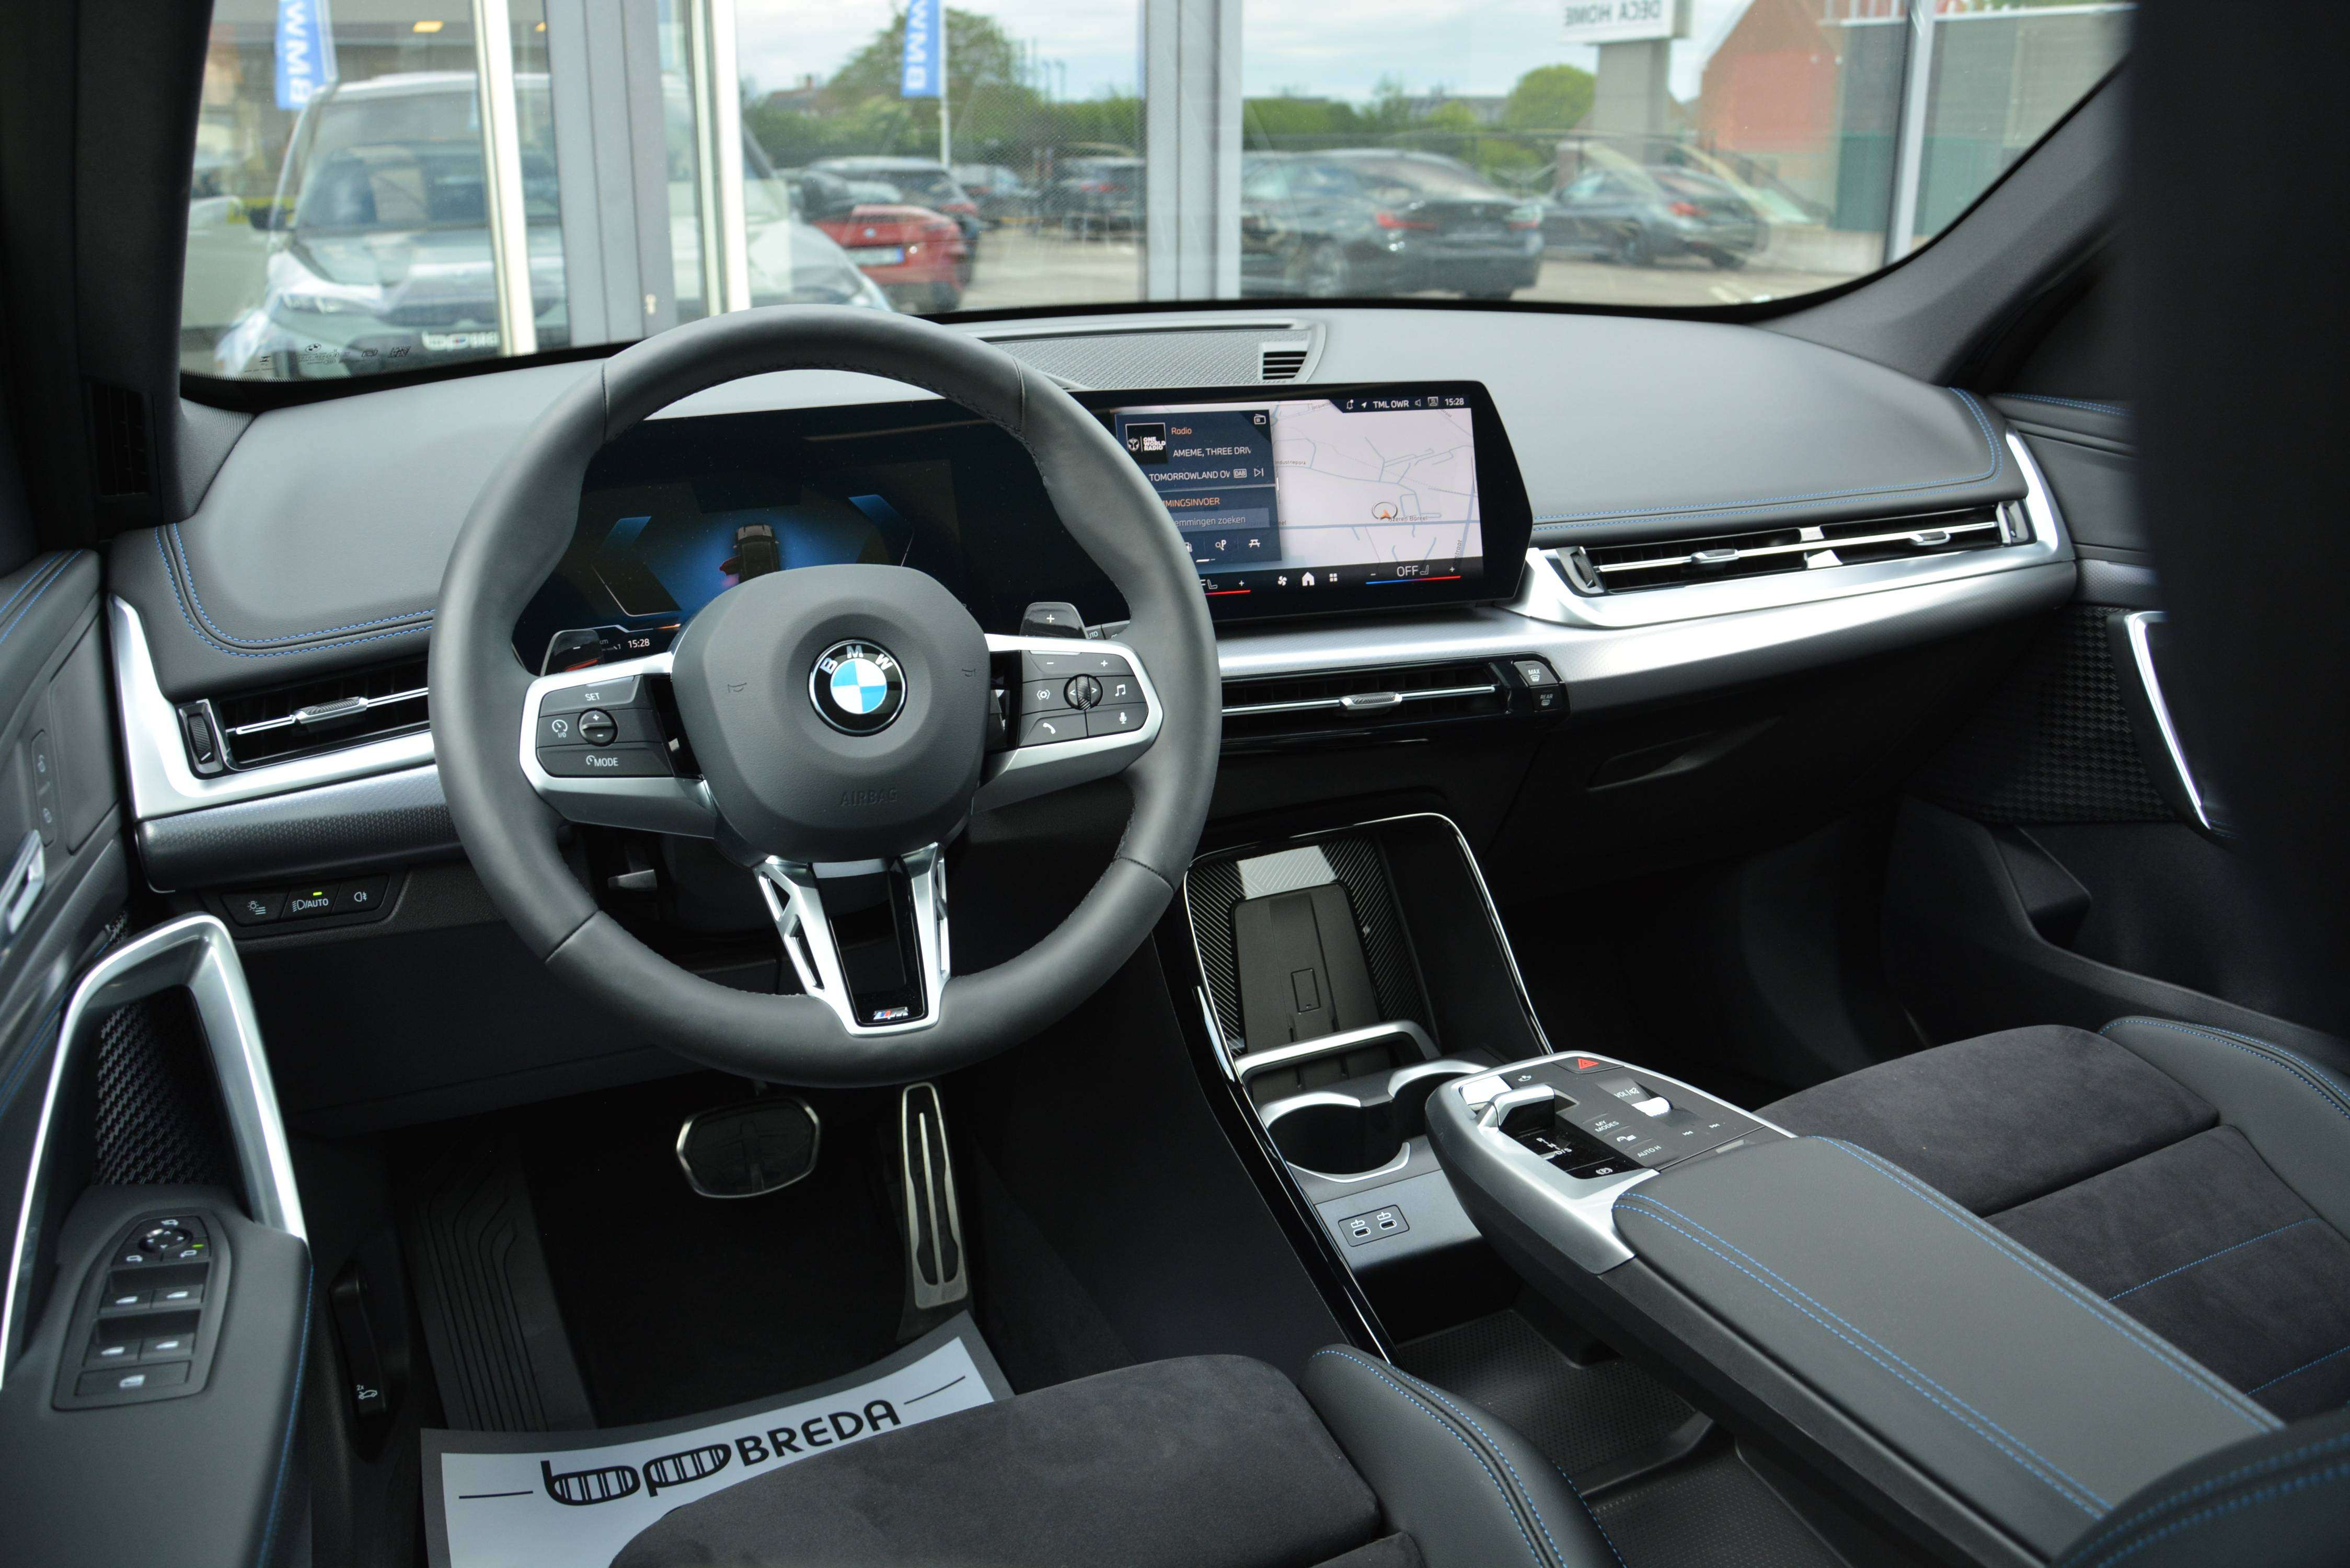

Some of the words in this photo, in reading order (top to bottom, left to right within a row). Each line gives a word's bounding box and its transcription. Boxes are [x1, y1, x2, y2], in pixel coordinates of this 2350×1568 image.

[1390, 400, 1410, 408] OWR
[1445, 398, 1465, 406] 15:28
[1172, 448, 1205, 457] AMEME,
[1205, 447, 1233, 456] THREE
[1149, 471, 1218, 482] TOMORROWLAND
[1163, 497, 1220, 507] MINGSINVOER
[1174, 517, 1216, 527] emmingen
[1218, 515, 1246, 524] zoeken
[1397, 565, 1419, 577] OFF
[627, 638, 650, 649] 15:28
[820, 644, 893, 675] BMW
[585, 693, 601, 701] SET
[594, 757, 619, 767] MODE
[840, 788, 898, 806] AIRBAG
[1595, 1121, 1619, 1133] MODES
[1637, 1148, 1655, 1158] AUTO
[735, 1399, 902, 1467] BREDA
